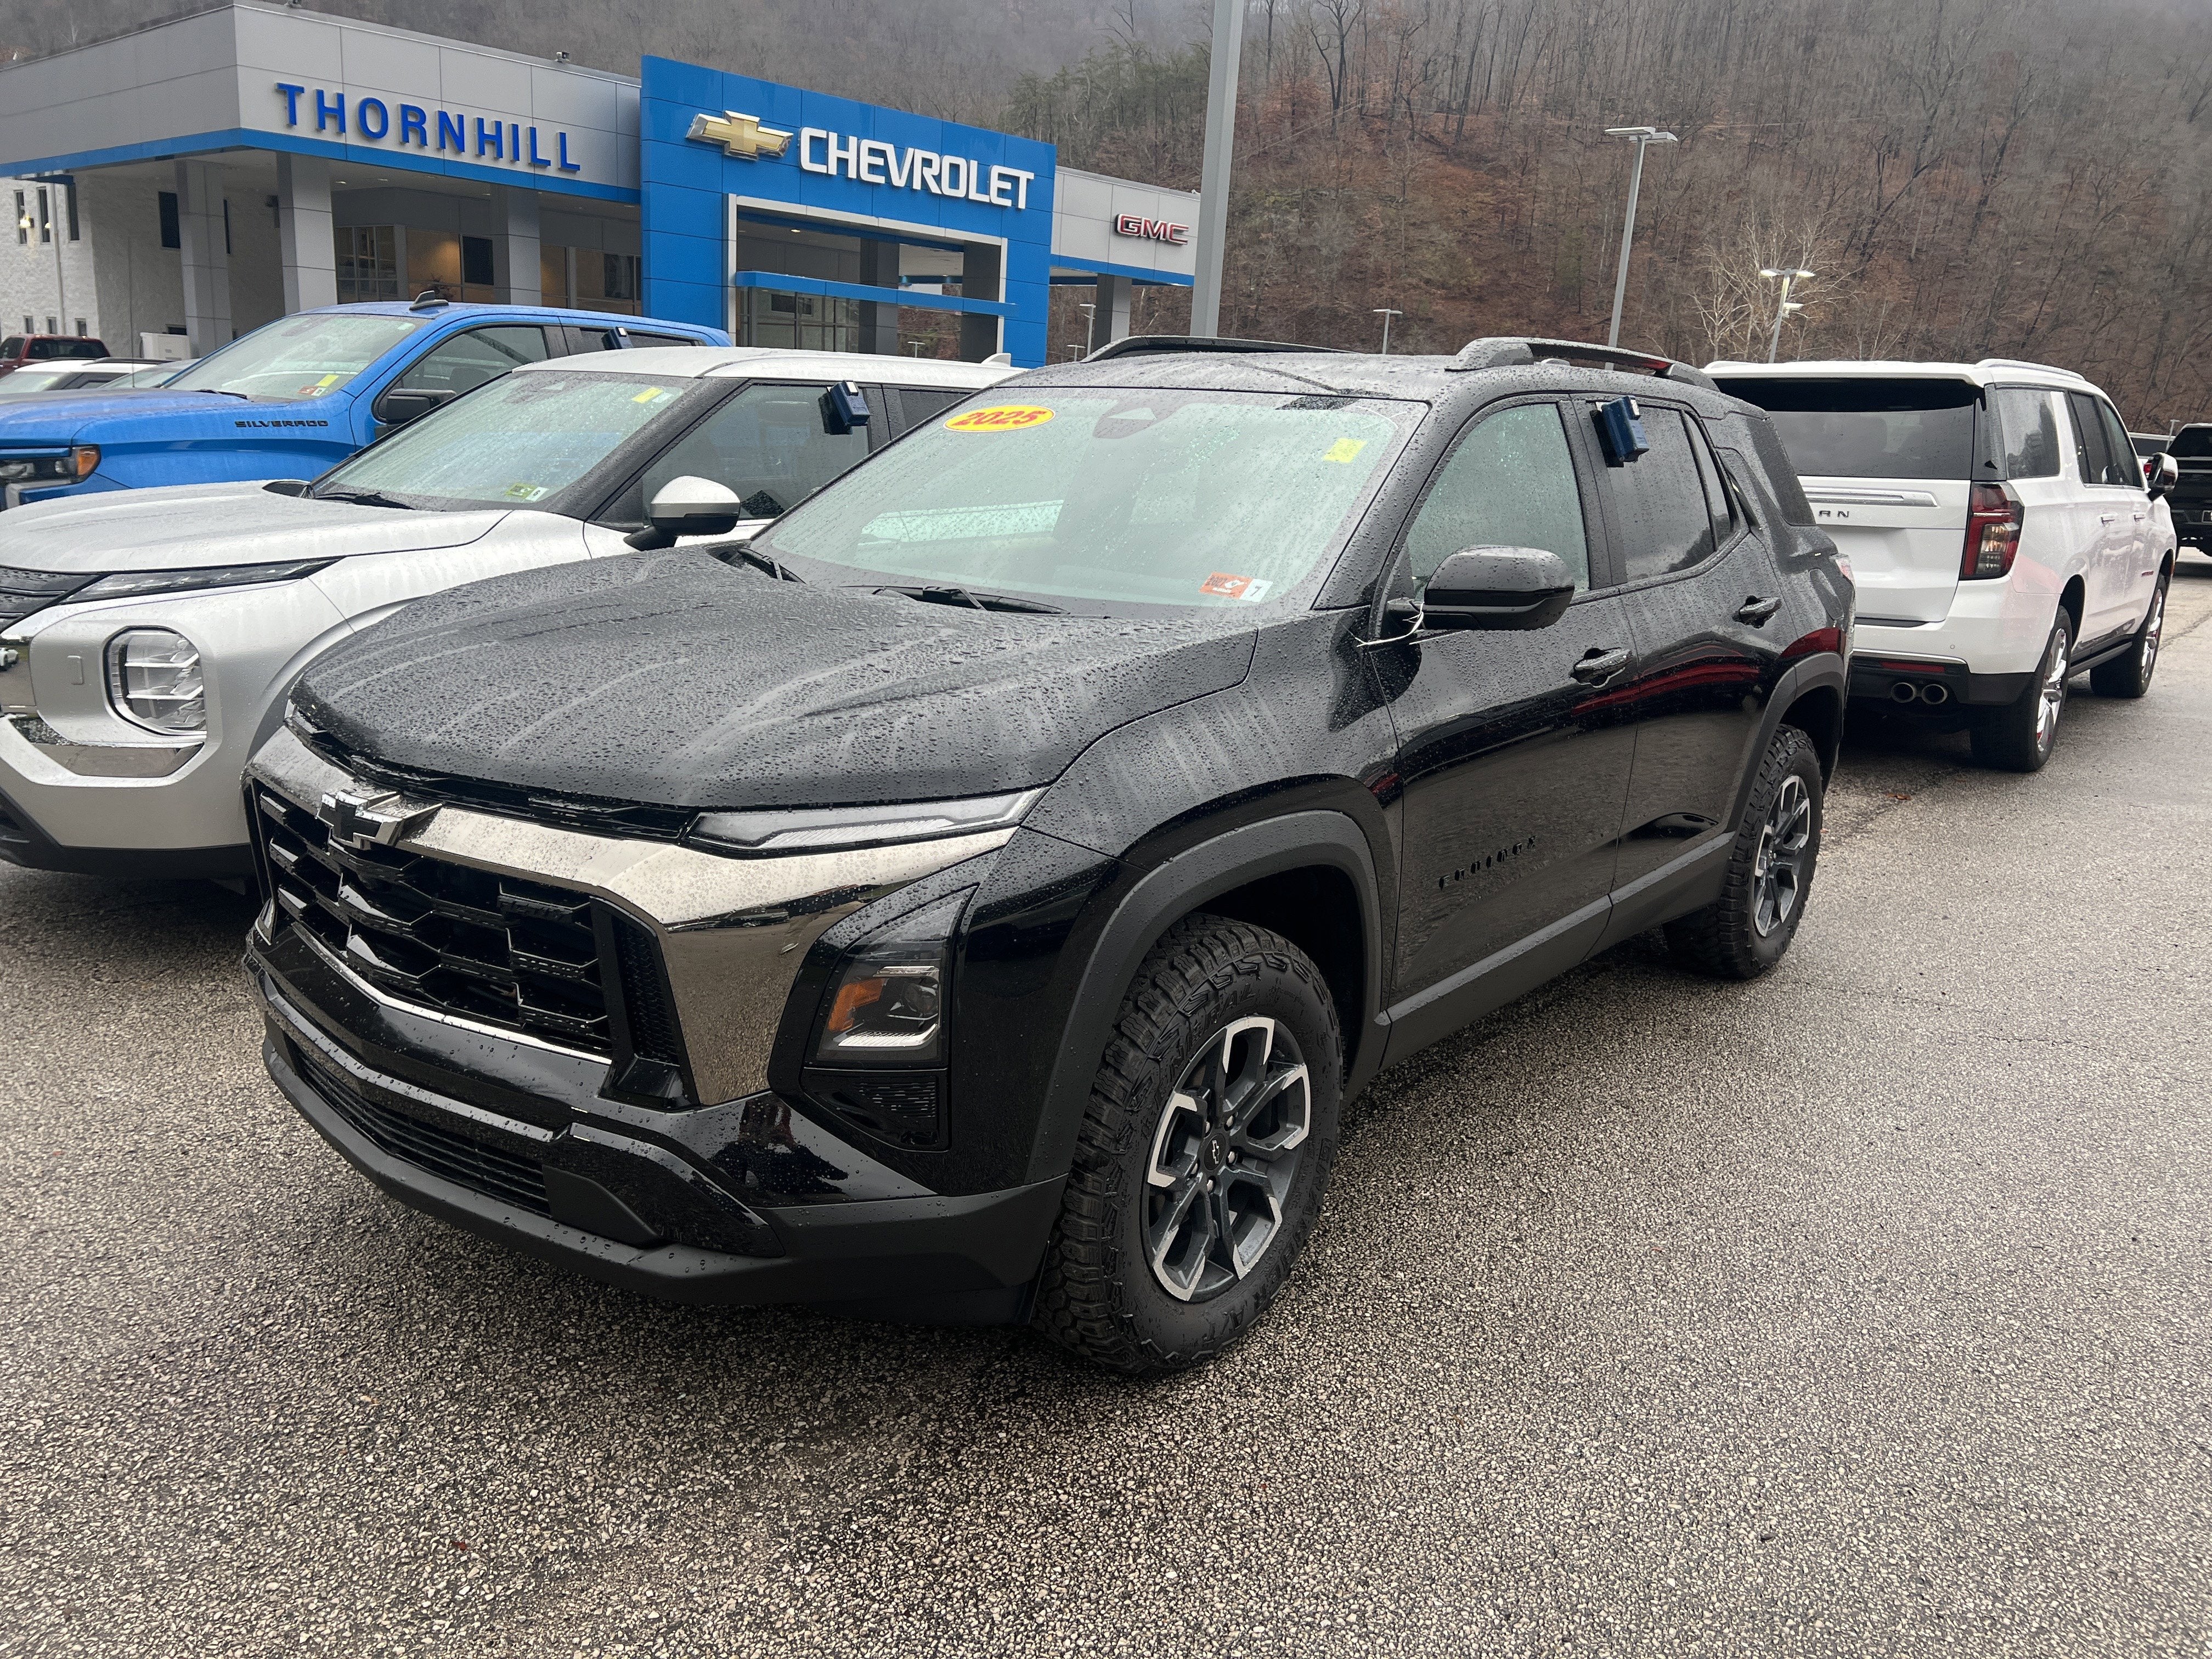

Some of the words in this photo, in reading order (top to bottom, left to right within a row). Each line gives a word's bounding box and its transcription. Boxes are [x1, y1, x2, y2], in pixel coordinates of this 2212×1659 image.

[276, 82, 580, 172] THORNHILL
[800, 126, 1035, 210] CHEVROLET
[1115, 213, 1189, 245] GMC
[234, 419, 329, 428] SILVERADO
[952, 410, 1046, 426] 2025
